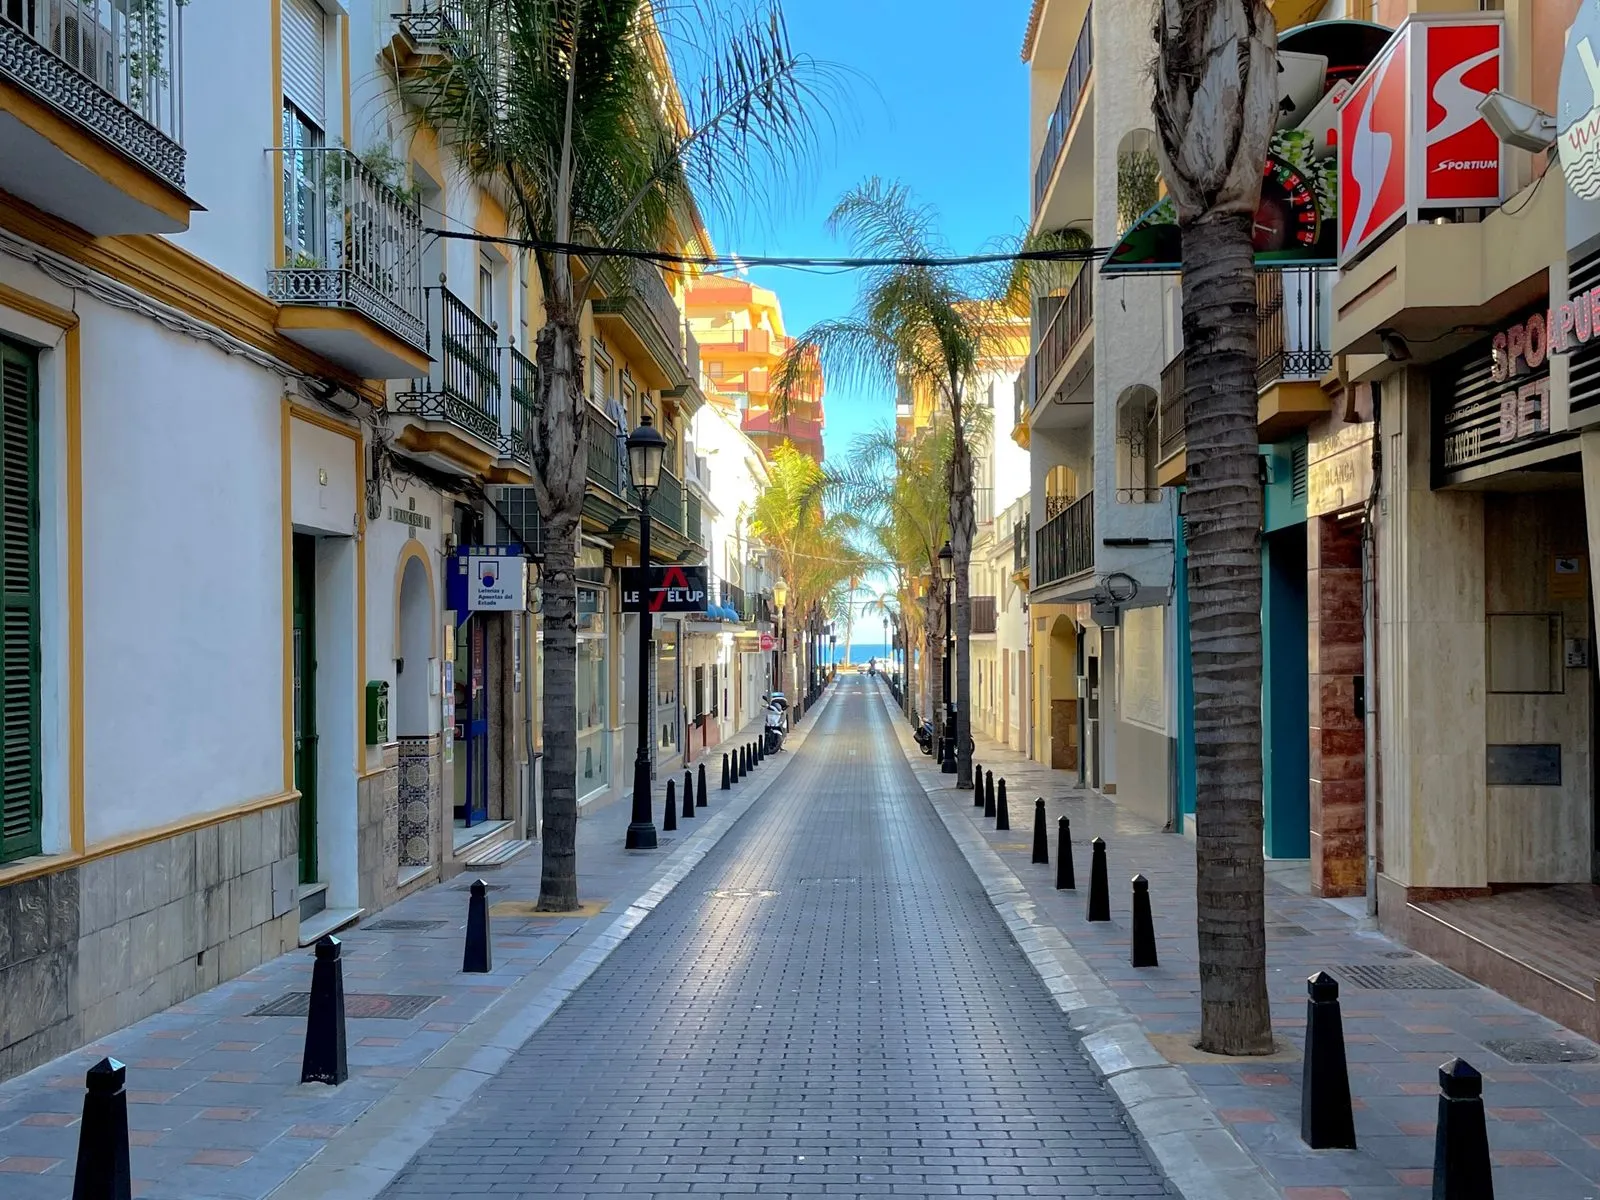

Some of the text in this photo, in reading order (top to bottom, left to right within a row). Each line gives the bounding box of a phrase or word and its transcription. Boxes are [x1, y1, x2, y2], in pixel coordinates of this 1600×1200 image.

[1430, 159, 1498, 173] SPORTIUM
[1444, 403, 1480, 425] EDIFICIO
[1499, 376, 1550, 444] BET
[686, 591, 704, 603] UP
